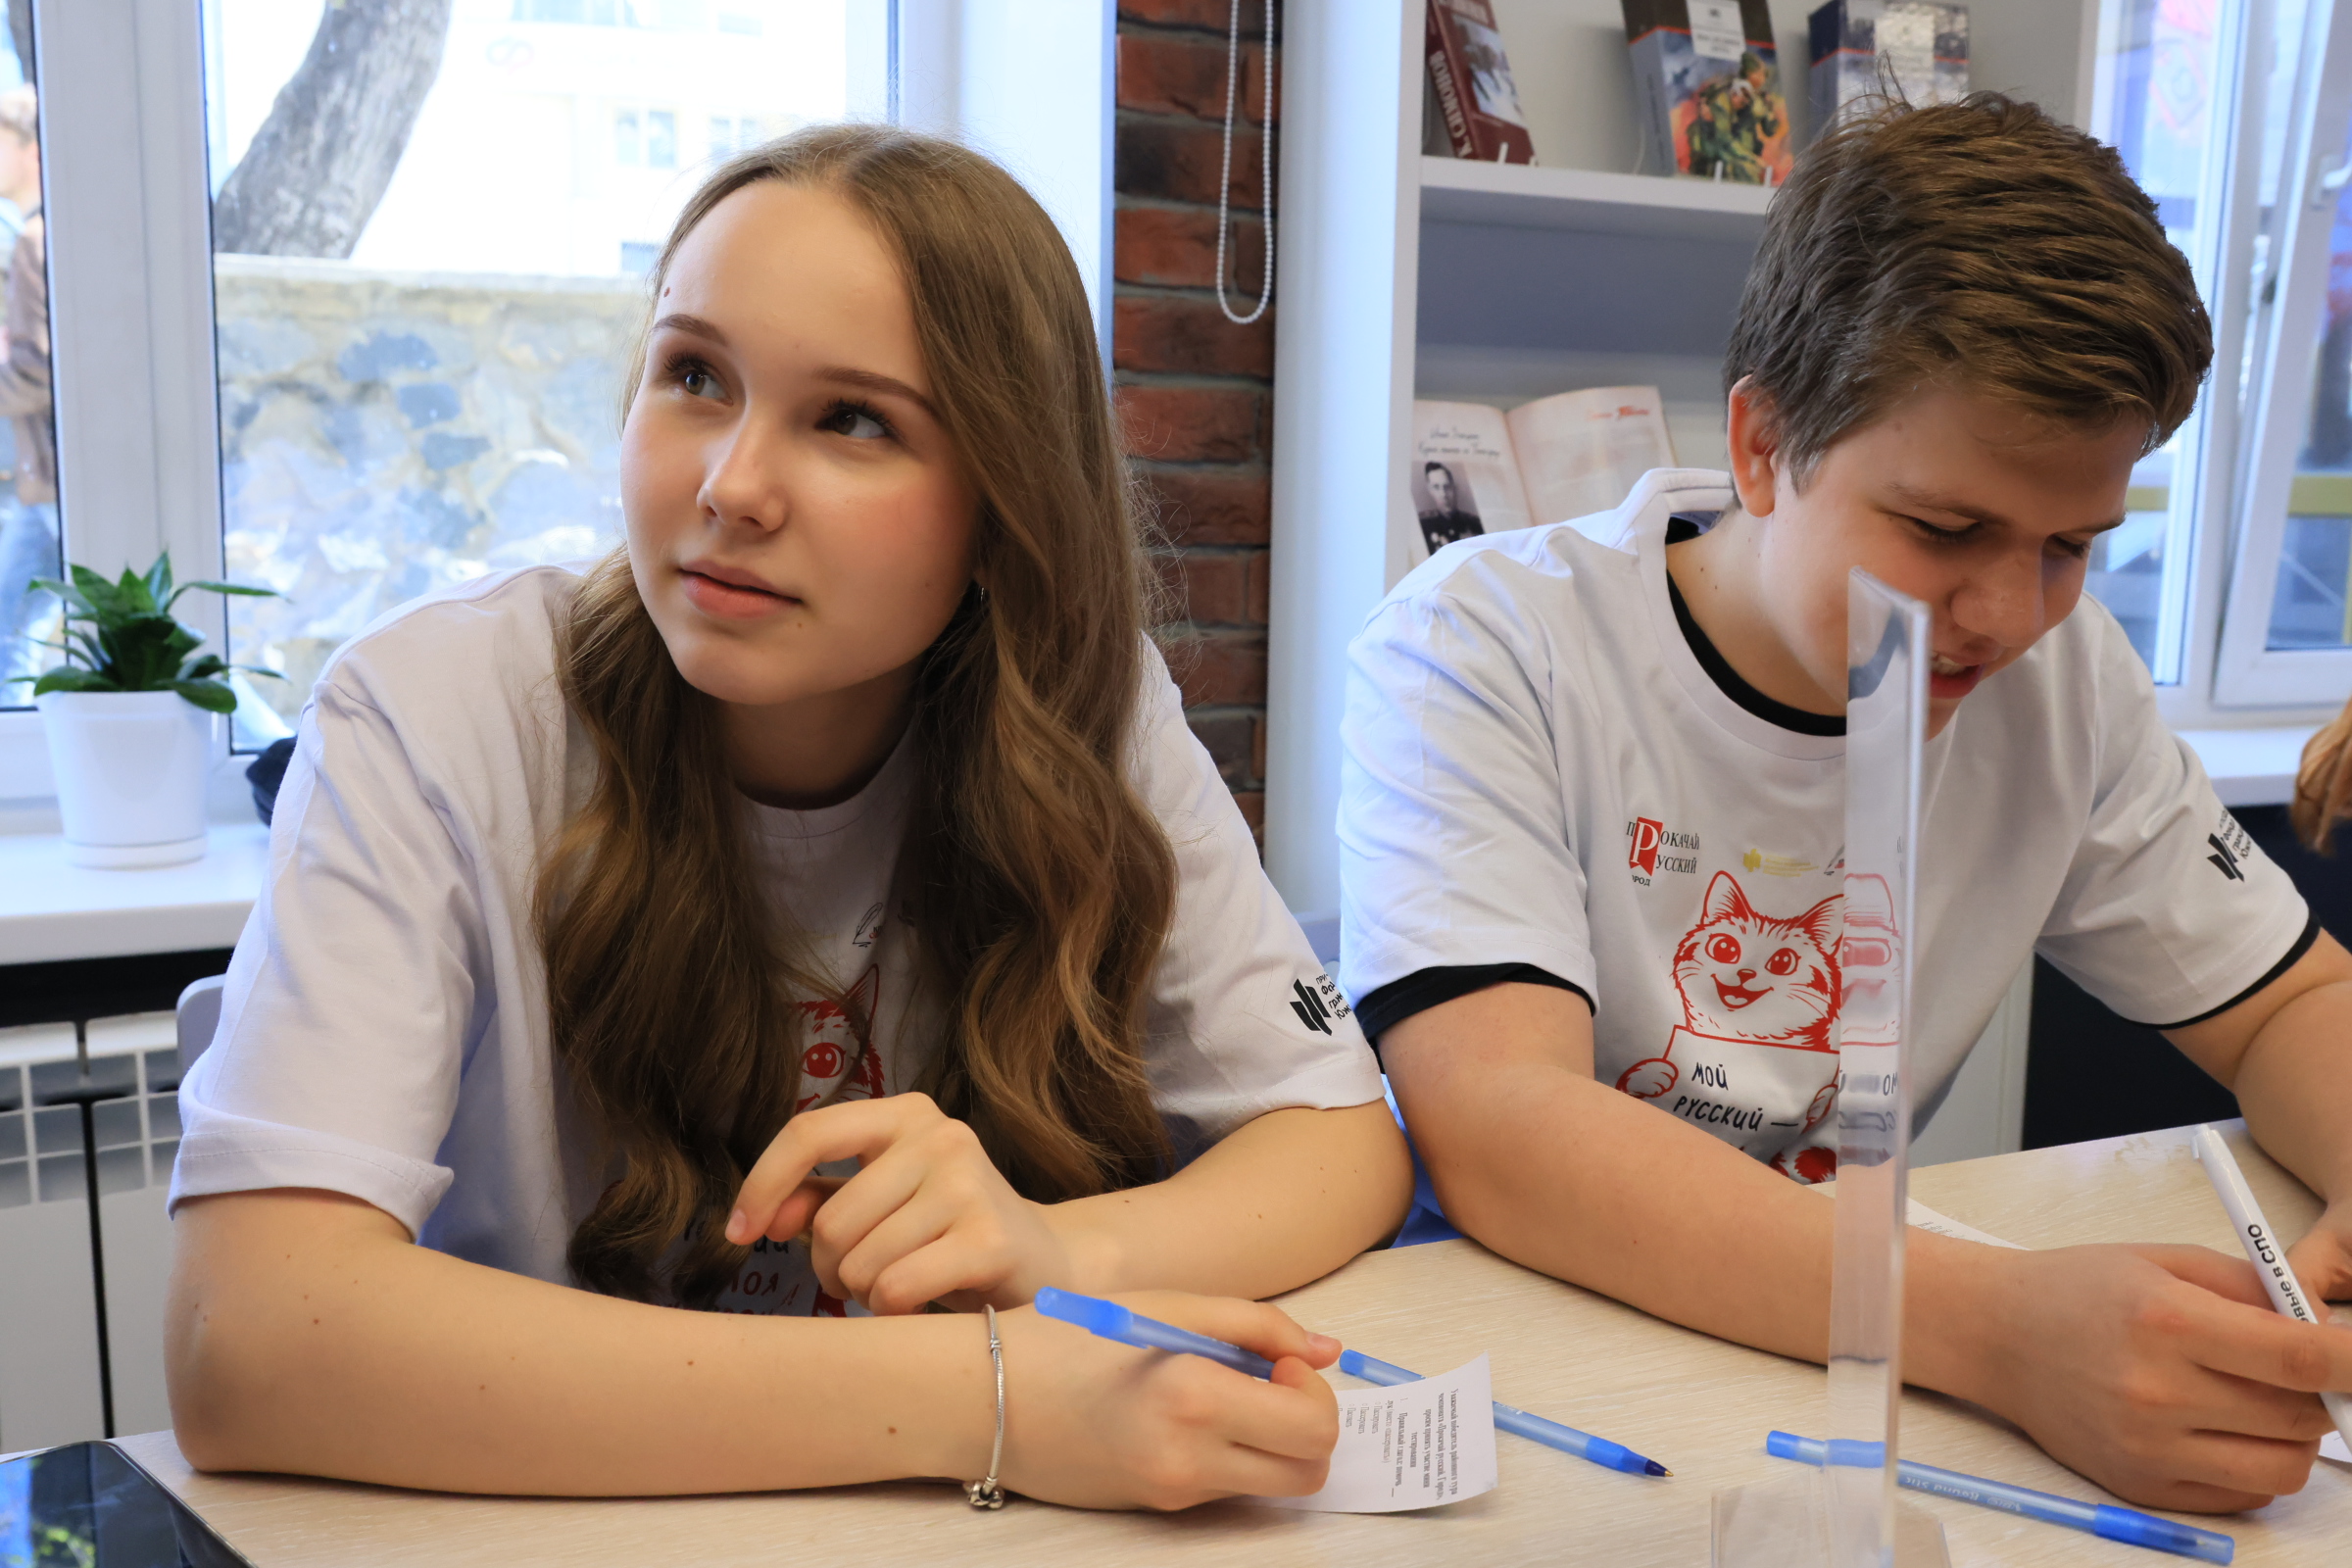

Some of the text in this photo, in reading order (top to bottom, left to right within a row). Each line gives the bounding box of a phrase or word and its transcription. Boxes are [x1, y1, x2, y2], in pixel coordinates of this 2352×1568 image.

[1691, 1061, 1729, 1091] МОЙ
[1673, 1096, 1763, 1132] РУССКИЙ
[2247, 1224, 2276, 1264] СПО
